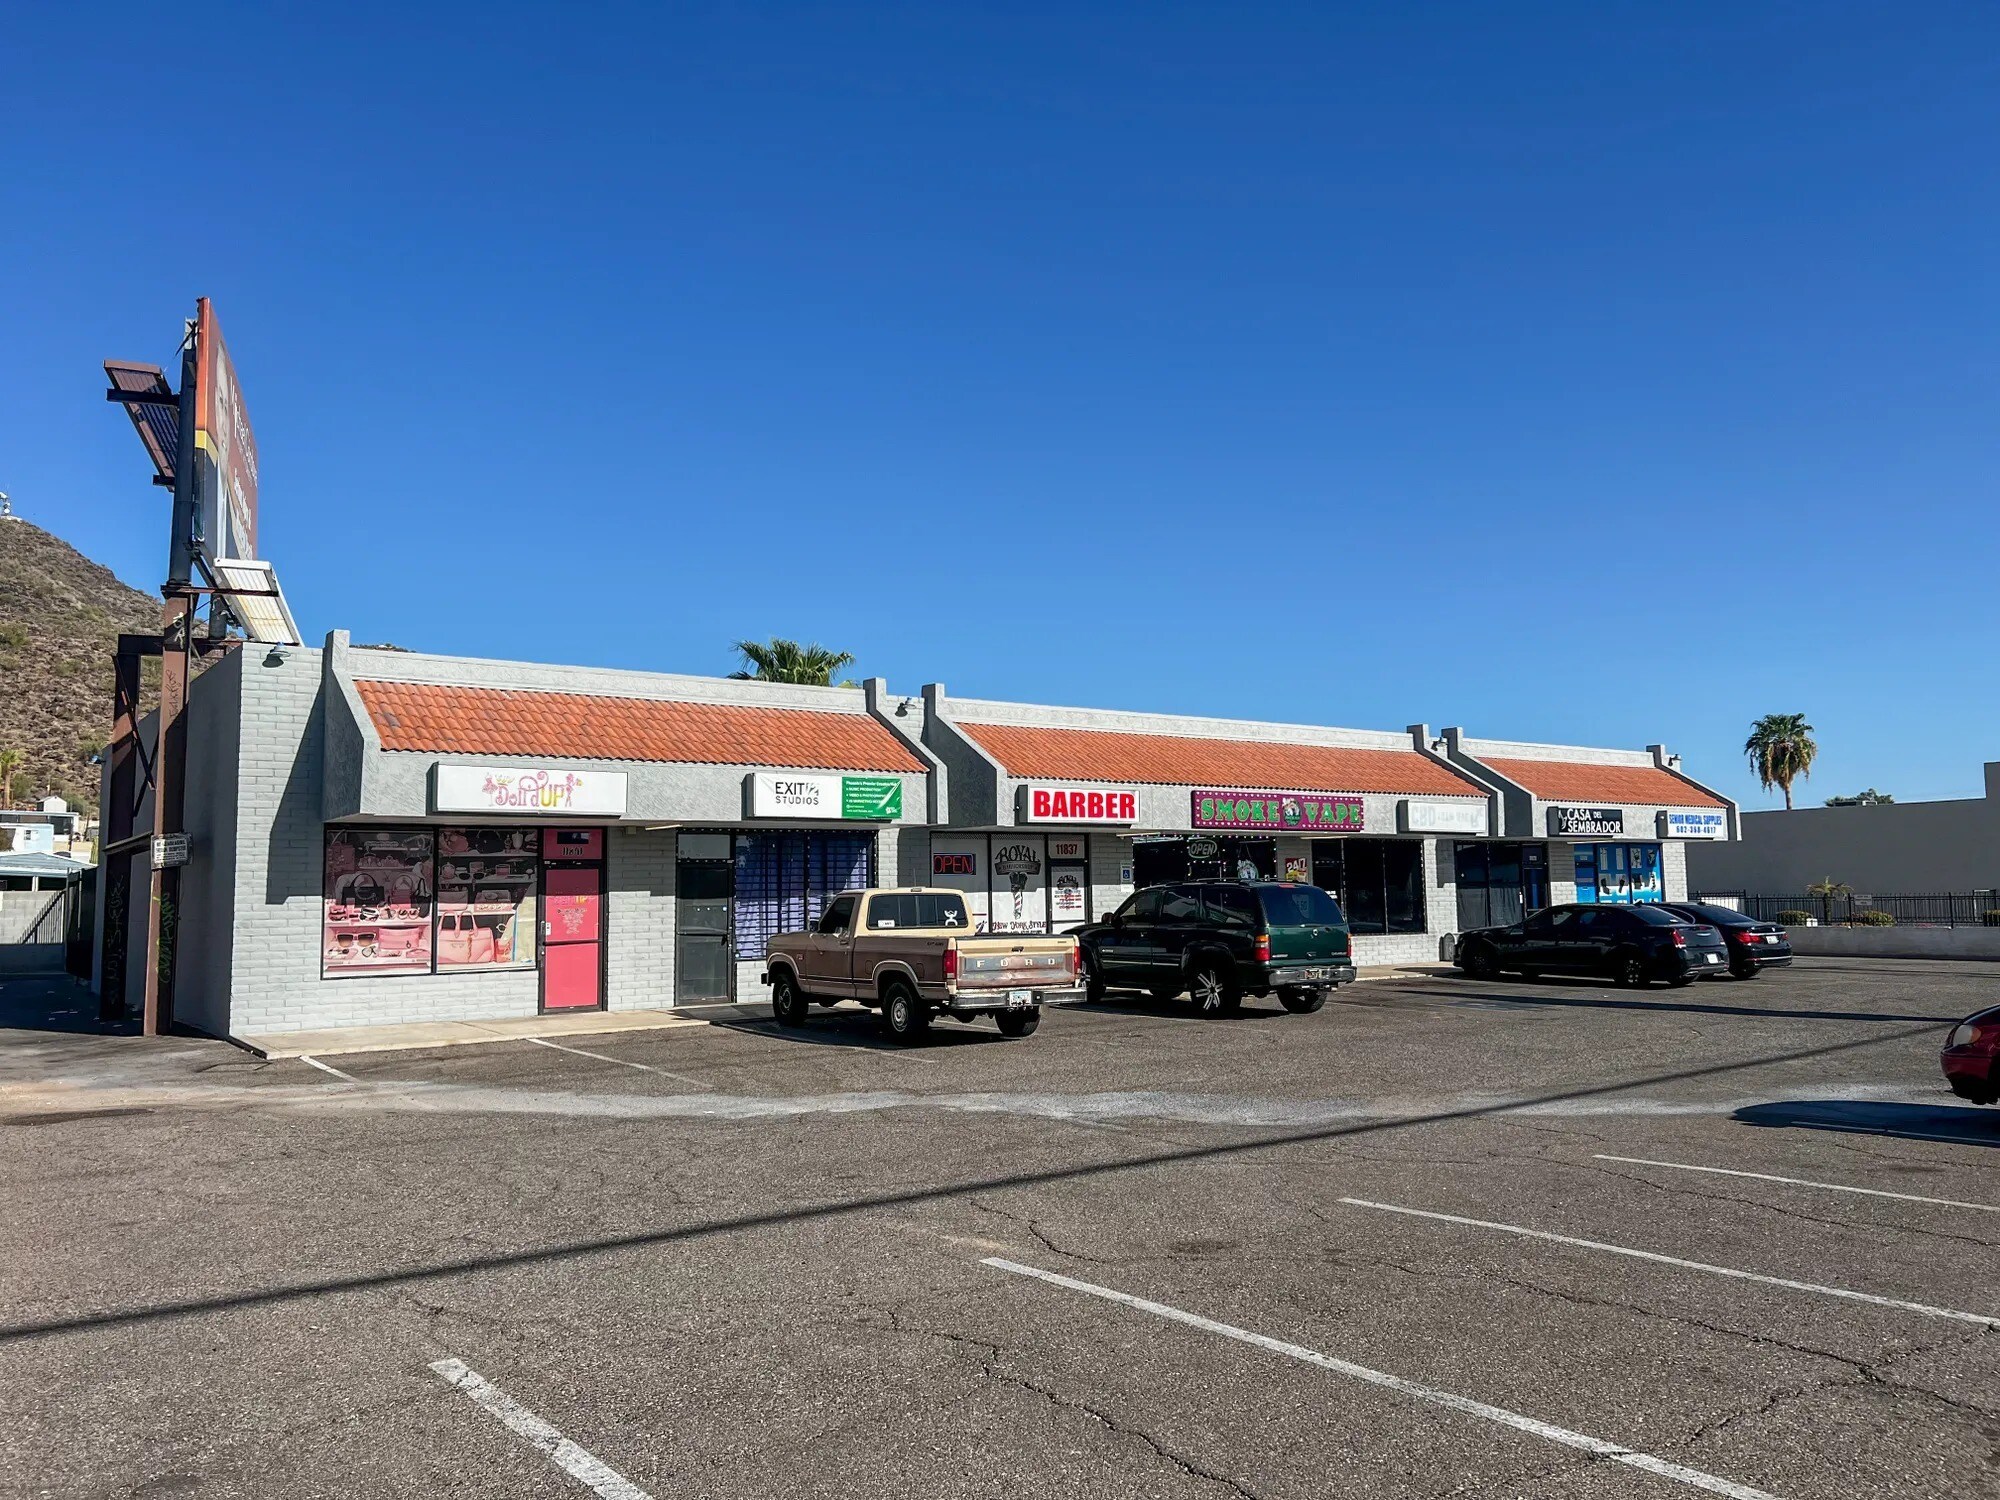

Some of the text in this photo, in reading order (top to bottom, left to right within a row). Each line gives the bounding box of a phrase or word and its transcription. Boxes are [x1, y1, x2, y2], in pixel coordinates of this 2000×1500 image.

[775, 781, 805, 795] EXIT
[541, 784, 565, 807] UP
[775, 795, 819, 805] STUDIOS
[1033, 790, 1136, 819] BARBER
[1201, 798, 1280, 823] SMOKE
[1304, 802, 1361, 824] VAPE
[1567, 808, 1591, 821] CASA
[1685, 814, 1703, 825] MEDICAL
[1703, 815, 1722, 826] SUPPLIES
[1567, 820, 1621, 833] SEMBRADOR
[995, 845, 1041, 862] ROYAL
[1056, 844, 1077, 855] 11837
[1190, 843, 1214, 855] OPEN
[934, 855, 973, 873] OPEN
[976, 958, 1056, 968] FORD
